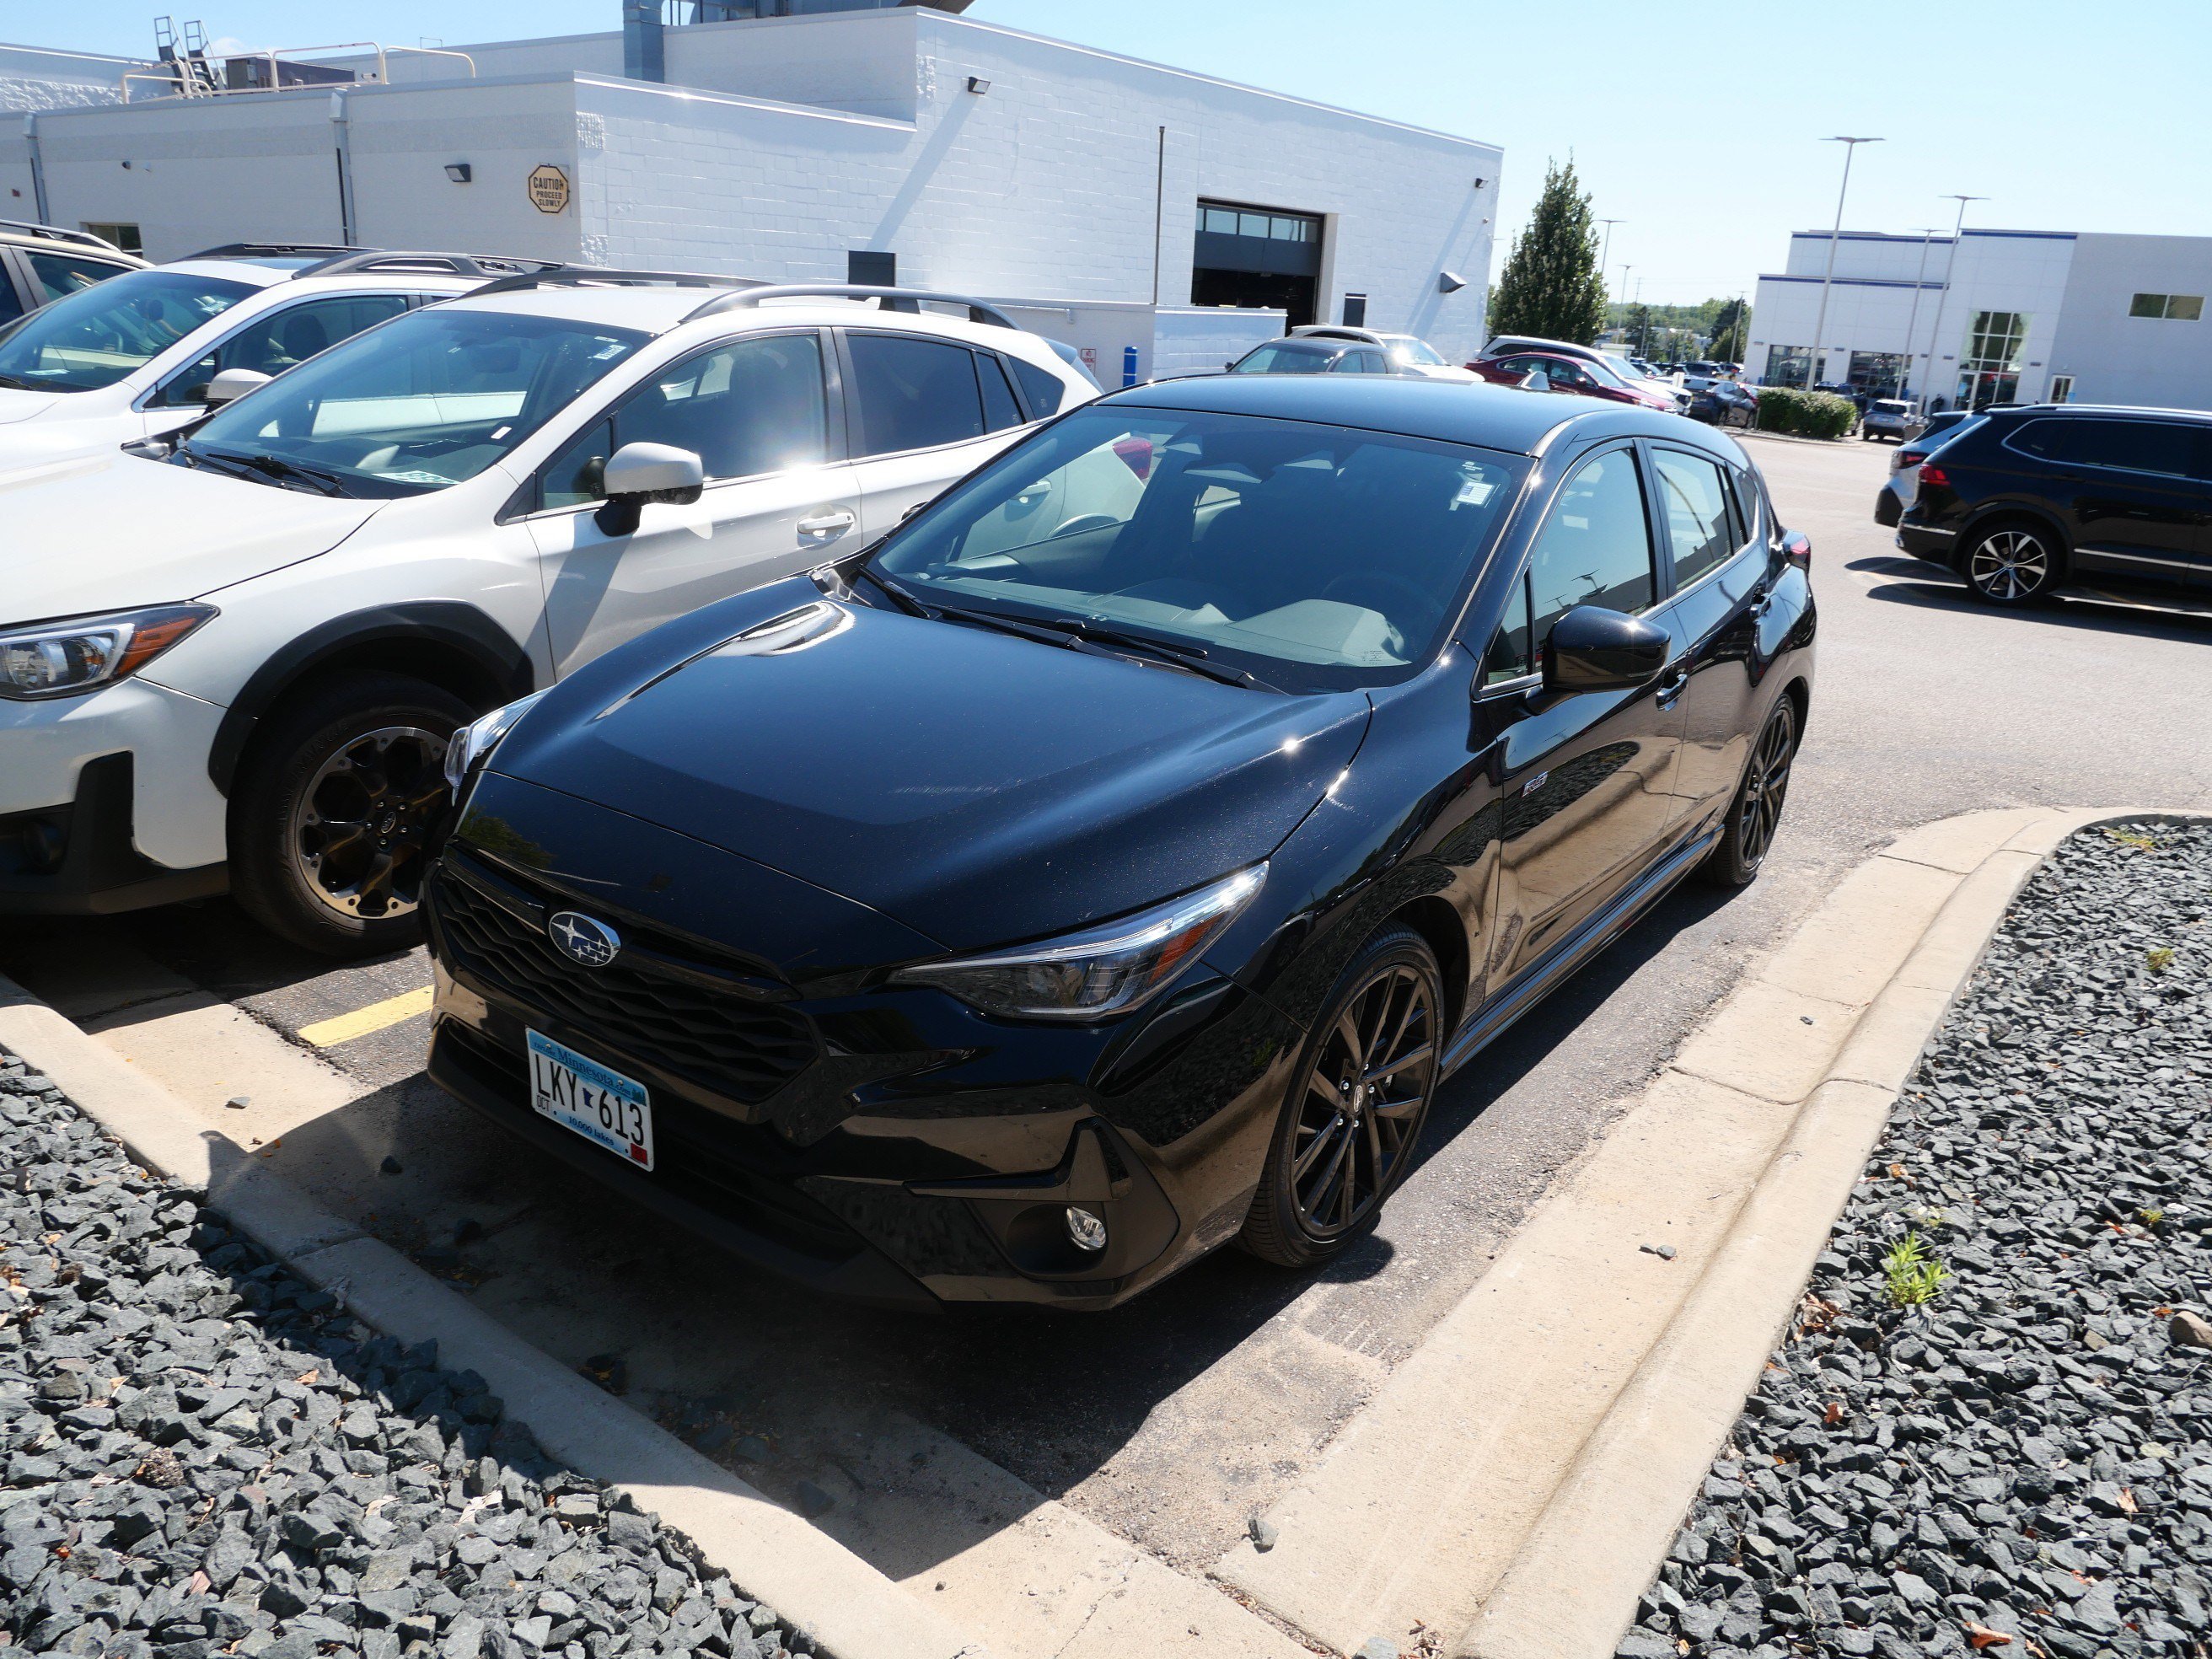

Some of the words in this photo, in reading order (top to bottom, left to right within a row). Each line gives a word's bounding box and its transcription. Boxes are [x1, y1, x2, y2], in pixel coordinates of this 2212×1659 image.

[534, 177, 564, 191] CAUTION
[536, 191, 562, 199] PROCEED
[556, 1047, 615, 1087] Minnesota
[534, 1054, 577, 1112] LKY
[599, 1089, 644, 1146] 613
[536, 1094, 550, 1112] OCT
[593, 1129, 615, 1146] lakes
